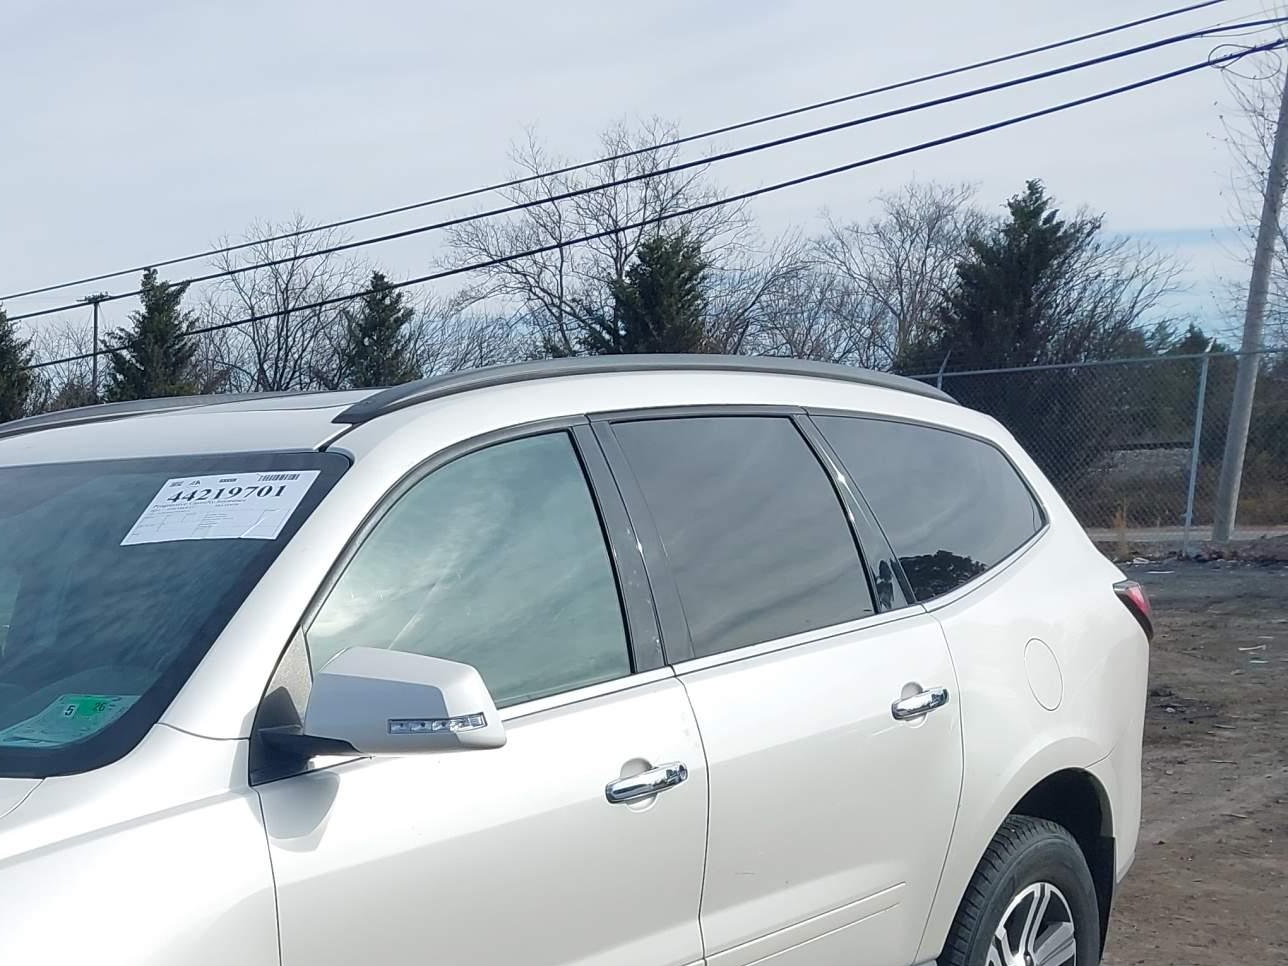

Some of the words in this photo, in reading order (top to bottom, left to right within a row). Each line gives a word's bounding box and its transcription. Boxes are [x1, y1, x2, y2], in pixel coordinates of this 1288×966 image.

[167, 484, 287, 502] 44219701
[64, 704, 76, 717] 5
[93, 702, 106, 712] 26
